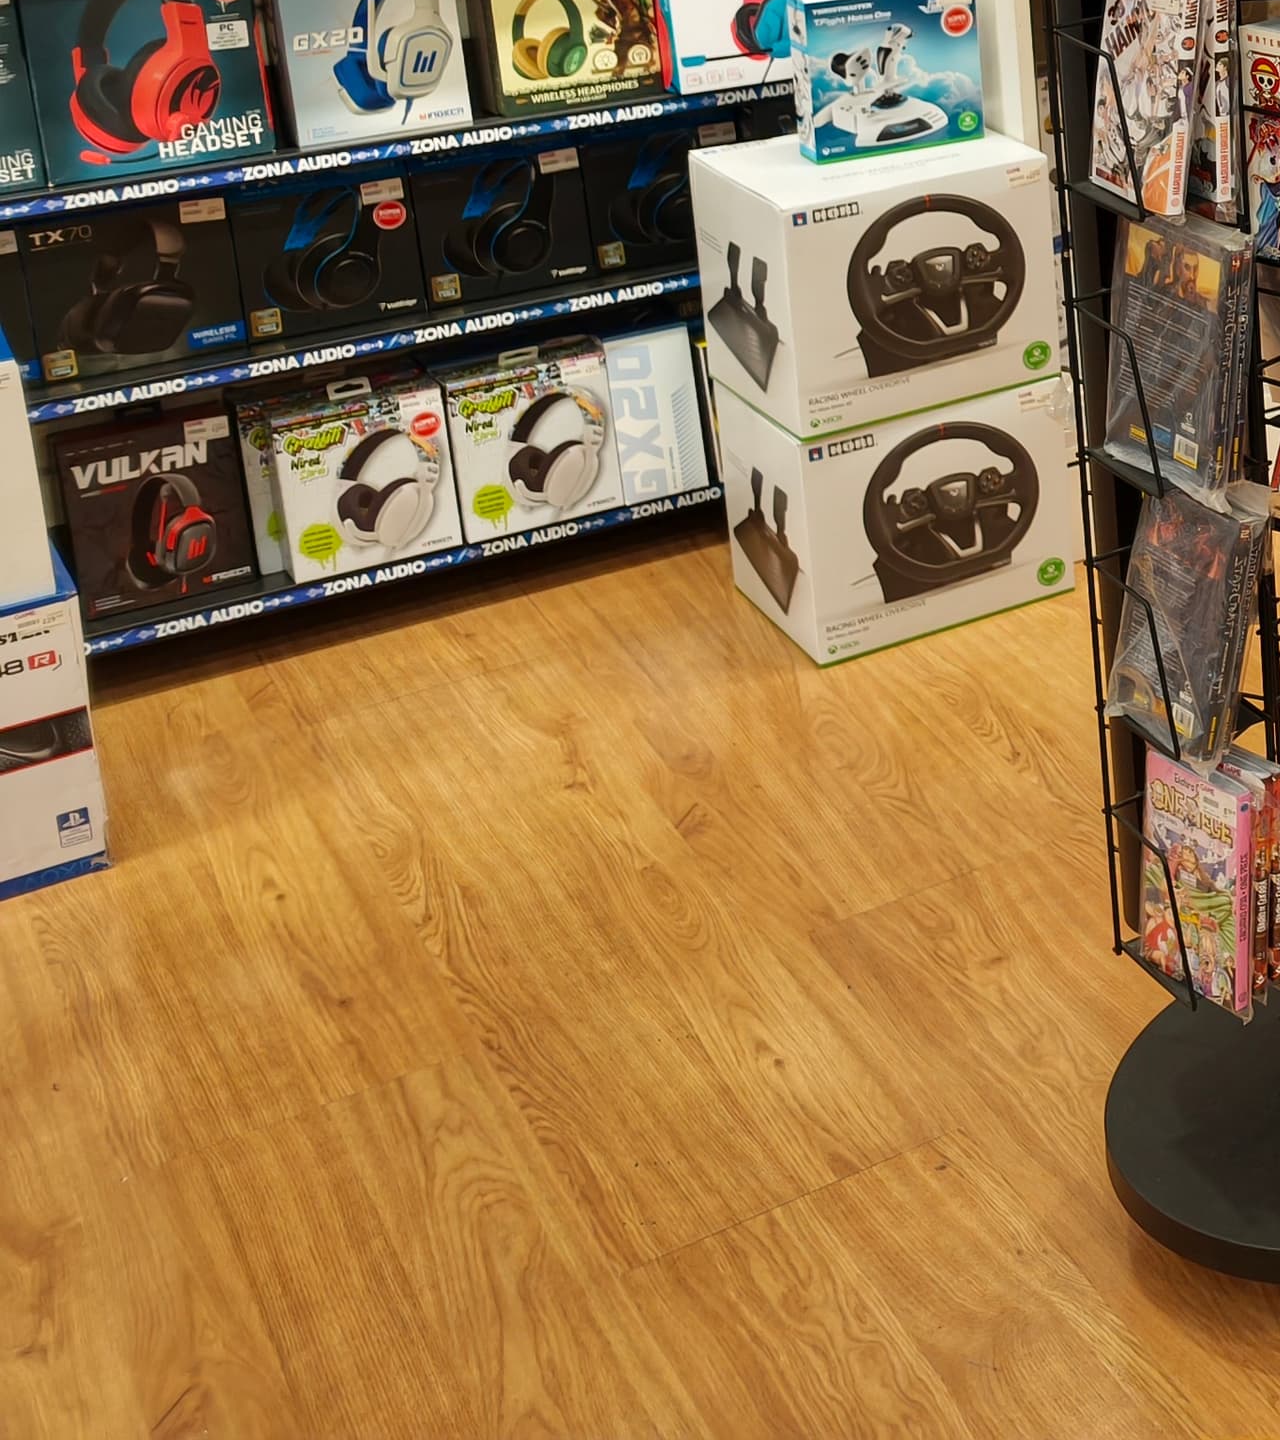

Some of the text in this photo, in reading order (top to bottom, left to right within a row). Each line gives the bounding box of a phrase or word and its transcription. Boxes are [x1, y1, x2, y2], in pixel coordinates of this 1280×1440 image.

[292, 26, 364, 51] GX20
[181, 116, 263, 141] GAMING
[159, 129, 264, 159] HEADSET
[70, 439, 209, 490] VULKAN
